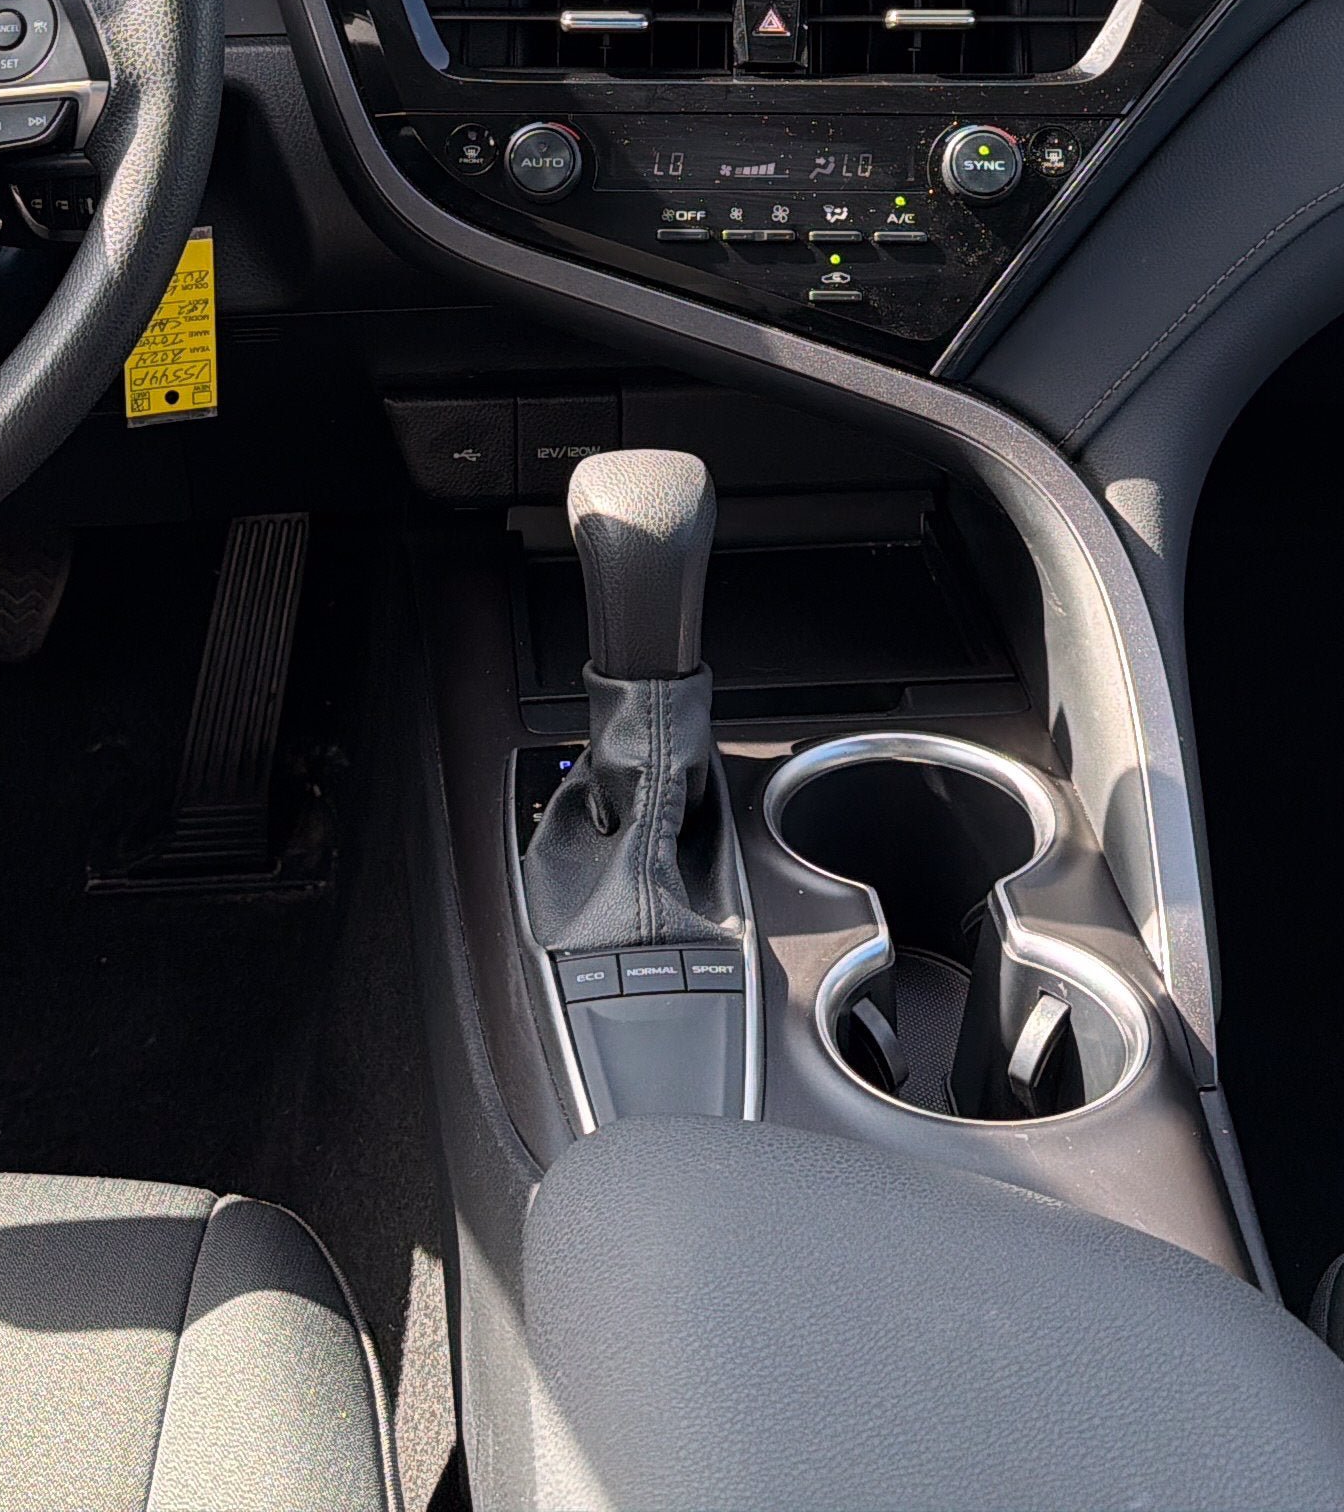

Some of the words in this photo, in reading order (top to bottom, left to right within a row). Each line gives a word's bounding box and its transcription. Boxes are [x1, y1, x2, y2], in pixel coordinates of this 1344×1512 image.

[0, 58, 19, 69] SET
[521, 157, 564, 168] AUTO
[963, 160, 1005, 171] SYNC
[675, 210, 706, 221] OFF
[886, 213, 916, 224] A/C
[181, 282, 209, 291] COLOR
[184, 314, 209, 323] MODEL
[188, 330, 210, 338] MAKE
[189, 346, 210, 354] YEAR
[559, 760, 571, 769] P
[626, 965, 678, 977] NORMAL
[691, 964, 735, 974] SPORT
[576, 971, 605, 983] ECO
